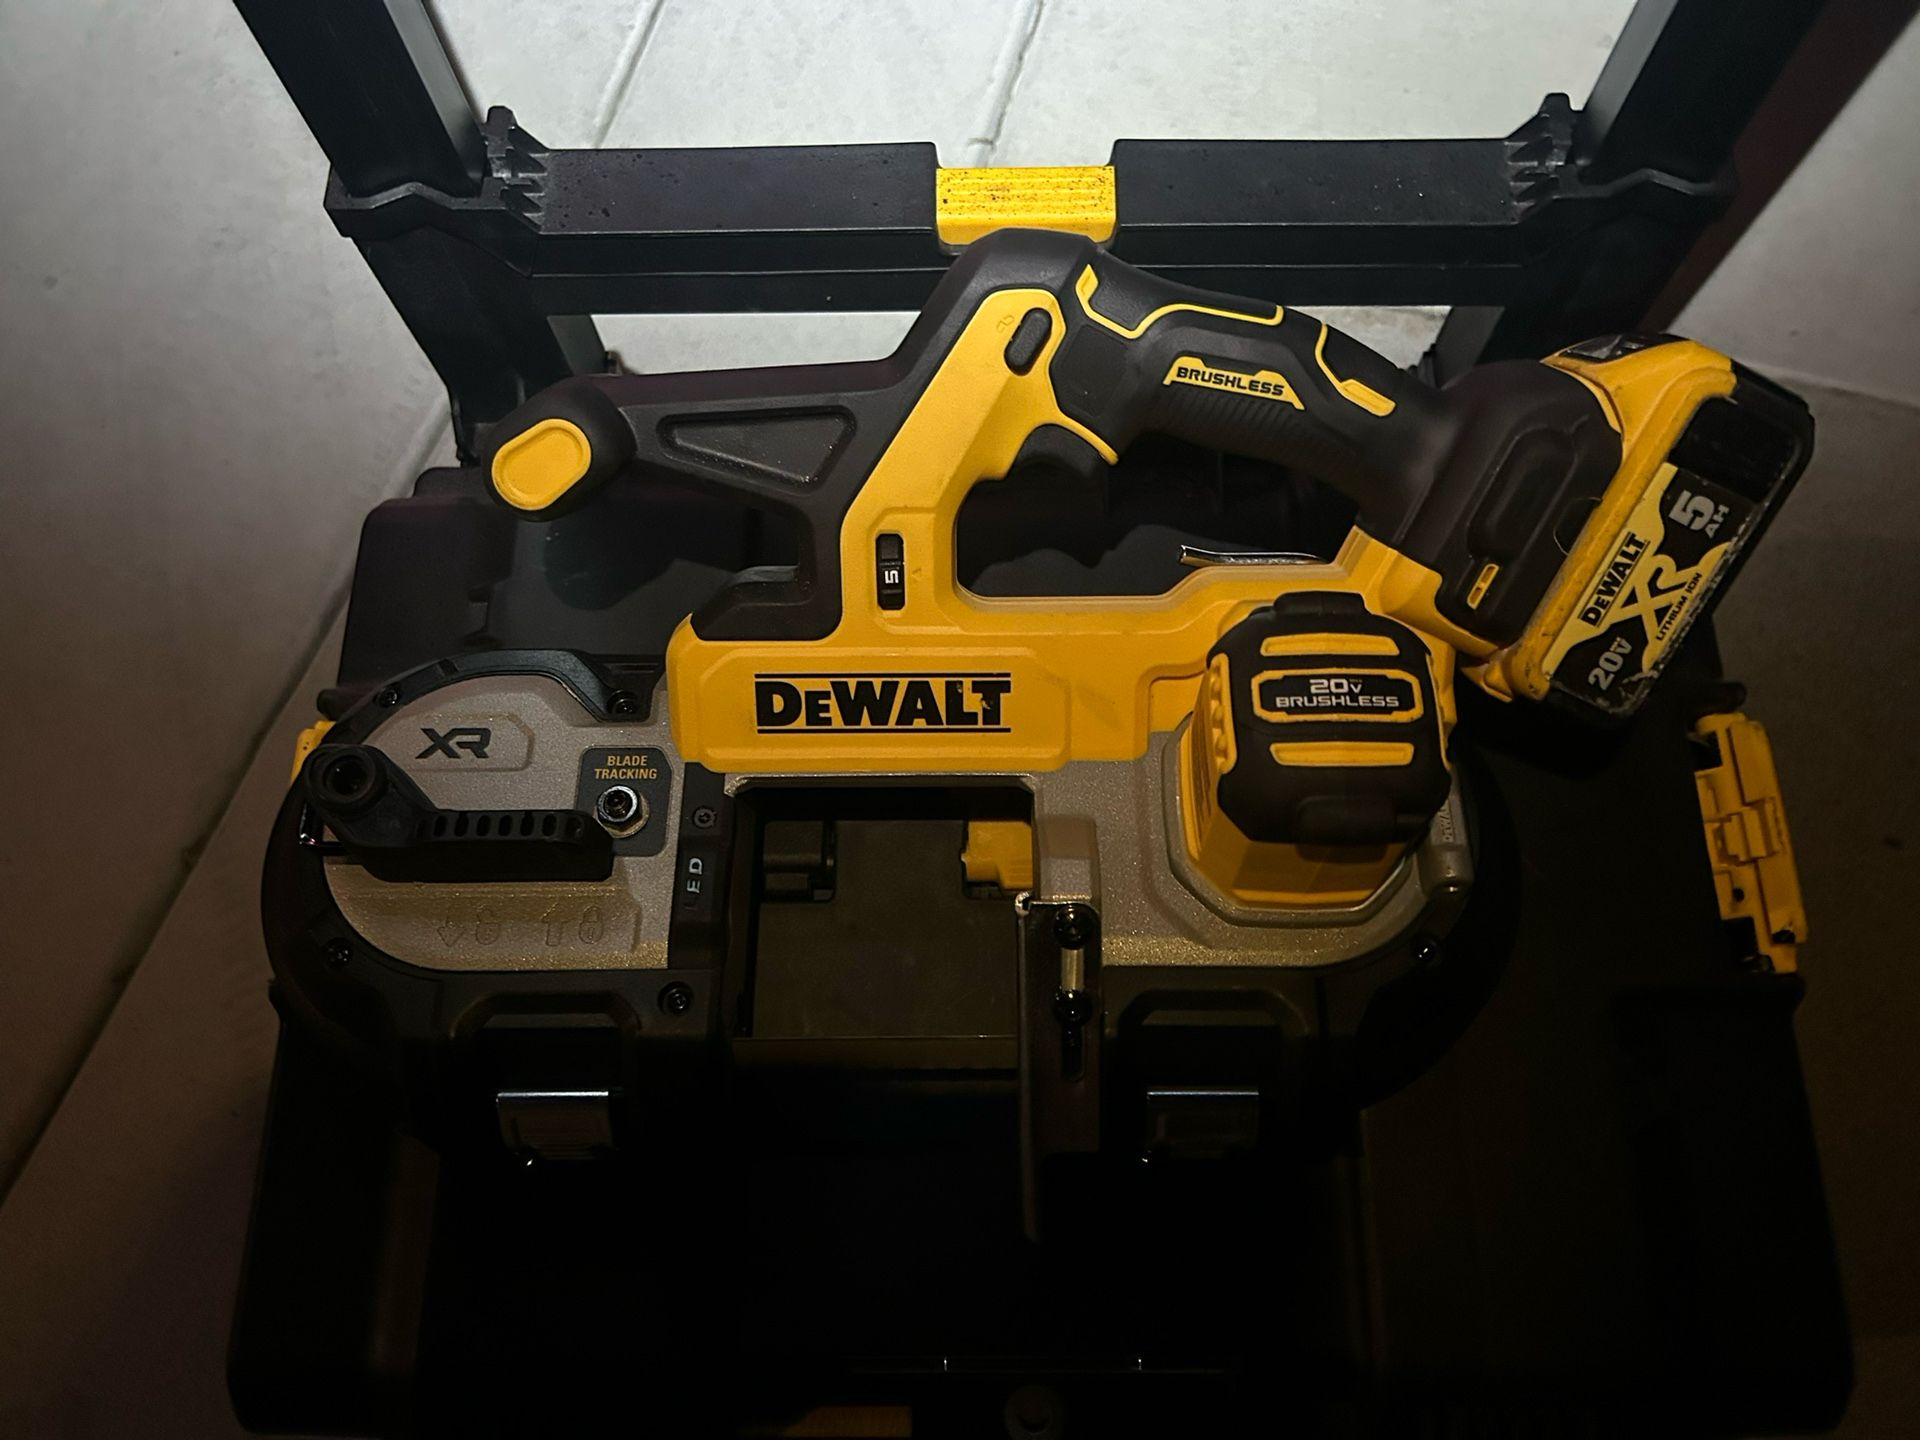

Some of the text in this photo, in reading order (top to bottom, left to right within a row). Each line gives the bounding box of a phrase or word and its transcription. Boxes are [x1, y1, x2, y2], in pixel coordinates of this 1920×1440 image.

[1176, 367, 1284, 396] BRUSHLESS
[1668, 490, 1715, 530] 5
[1580, 532, 1648, 627] DEWALT
[1656, 572, 1702, 640] LITHIUM ION
[754, 679, 1011, 727] DEWALT
[1275, 695, 1399, 708] BRUSHLESS
[415, 728, 491, 759] XR
[594, 768, 657, 780] TRACKING
[607, 755, 648, 766] BLADE
